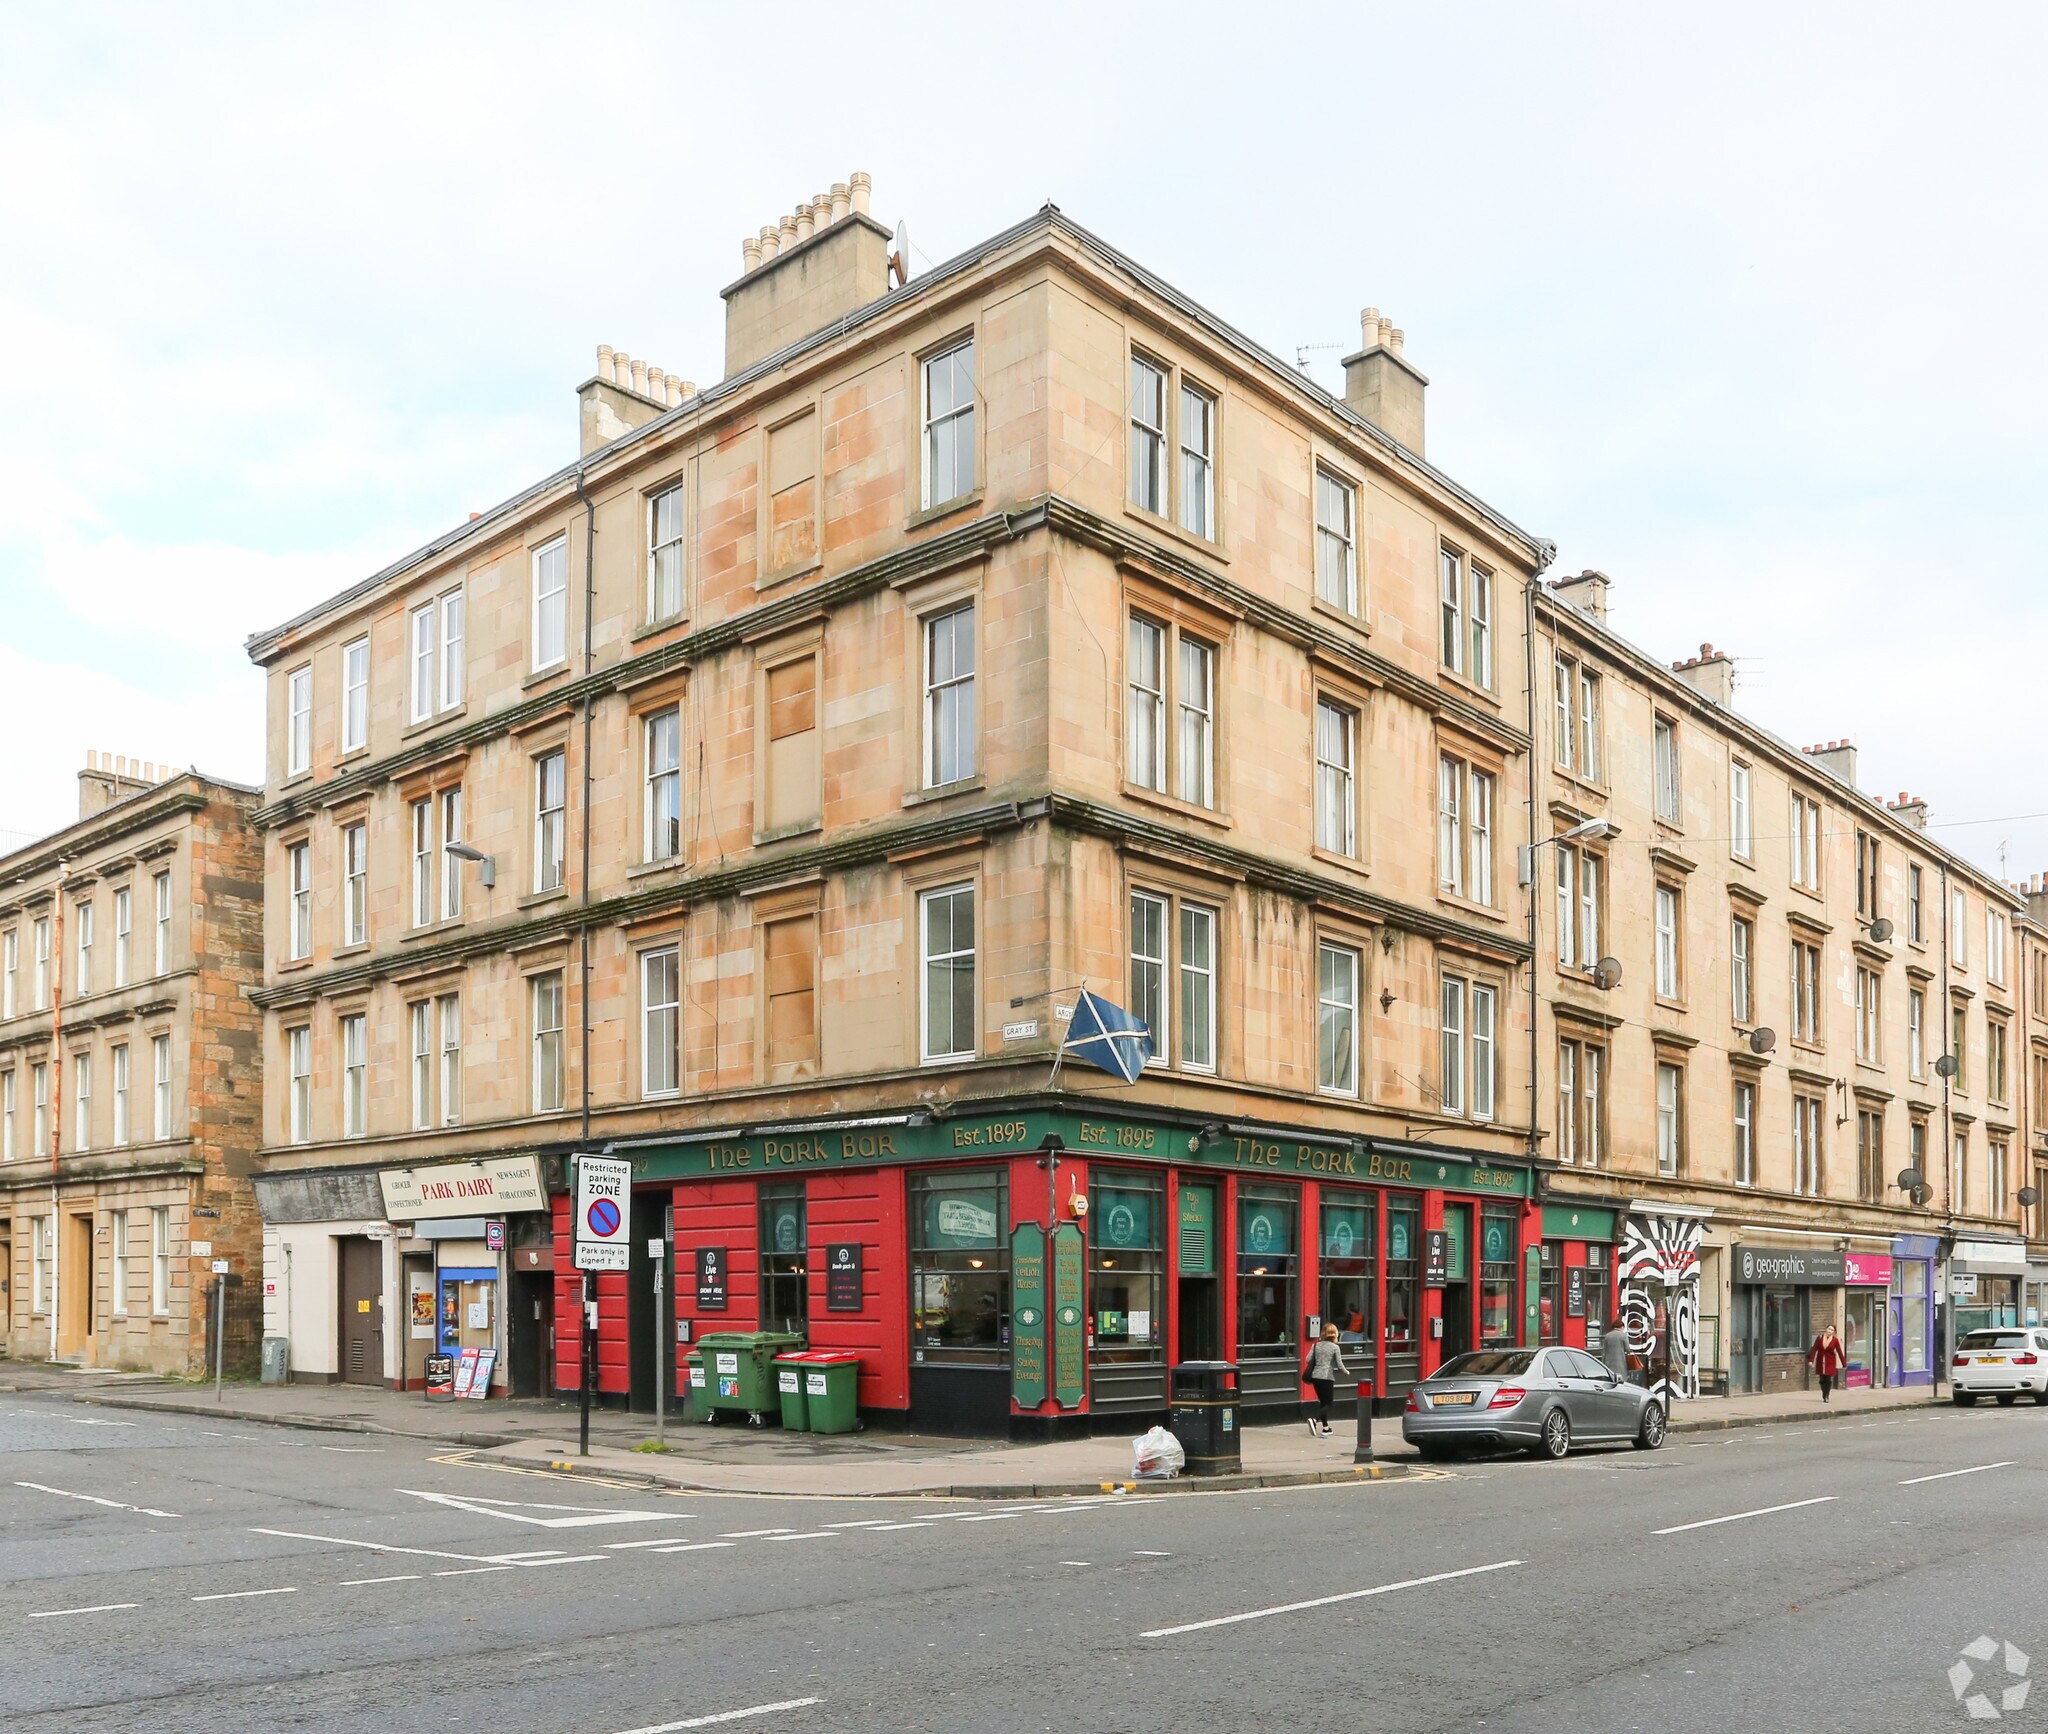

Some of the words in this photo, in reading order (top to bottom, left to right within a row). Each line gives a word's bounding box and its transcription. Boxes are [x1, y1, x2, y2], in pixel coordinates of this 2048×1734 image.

[1006, 1027, 1023, 1036] GRAY
[1025, 1025, 1033, 1033] ST
[953, 1127, 984, 1147] Est.
[985, 1121, 1026, 1143] 1895
[1079, 1122, 1110, 1144] Est.
[1115, 1126, 1155, 1149] 1895
[705, 1144, 751, 1169] The
[1233, 1137, 1281, 1166] The
[583, 1162, 628, 1174] Restricted
[496, 1169, 531, 1180] NEWSAGENT
[589, 1174, 621, 1185] parking
[1492, 1171, 1514, 1189] 1895
[391, 1181, 411, 1190] GROCER
[421, 1181, 454, 1200] PARK
[456, 1178, 494, 1198] DAIRY
[589, 1184, 620, 1196] ZONE
[498, 1189, 537, 1200] TOBACCONIST
[387, 1199, 423, 1209] CONFECTIONER
[581, 1246, 598, 1254] Park
[600, 1248, 616, 1256] only
[581, 1257, 605, 1265] signed
[1756, 1254, 1805, 1279] geo-graphics
[1017, 1279, 1039, 1290] Music
[1017, 1358, 1040, 1369] Sunday
